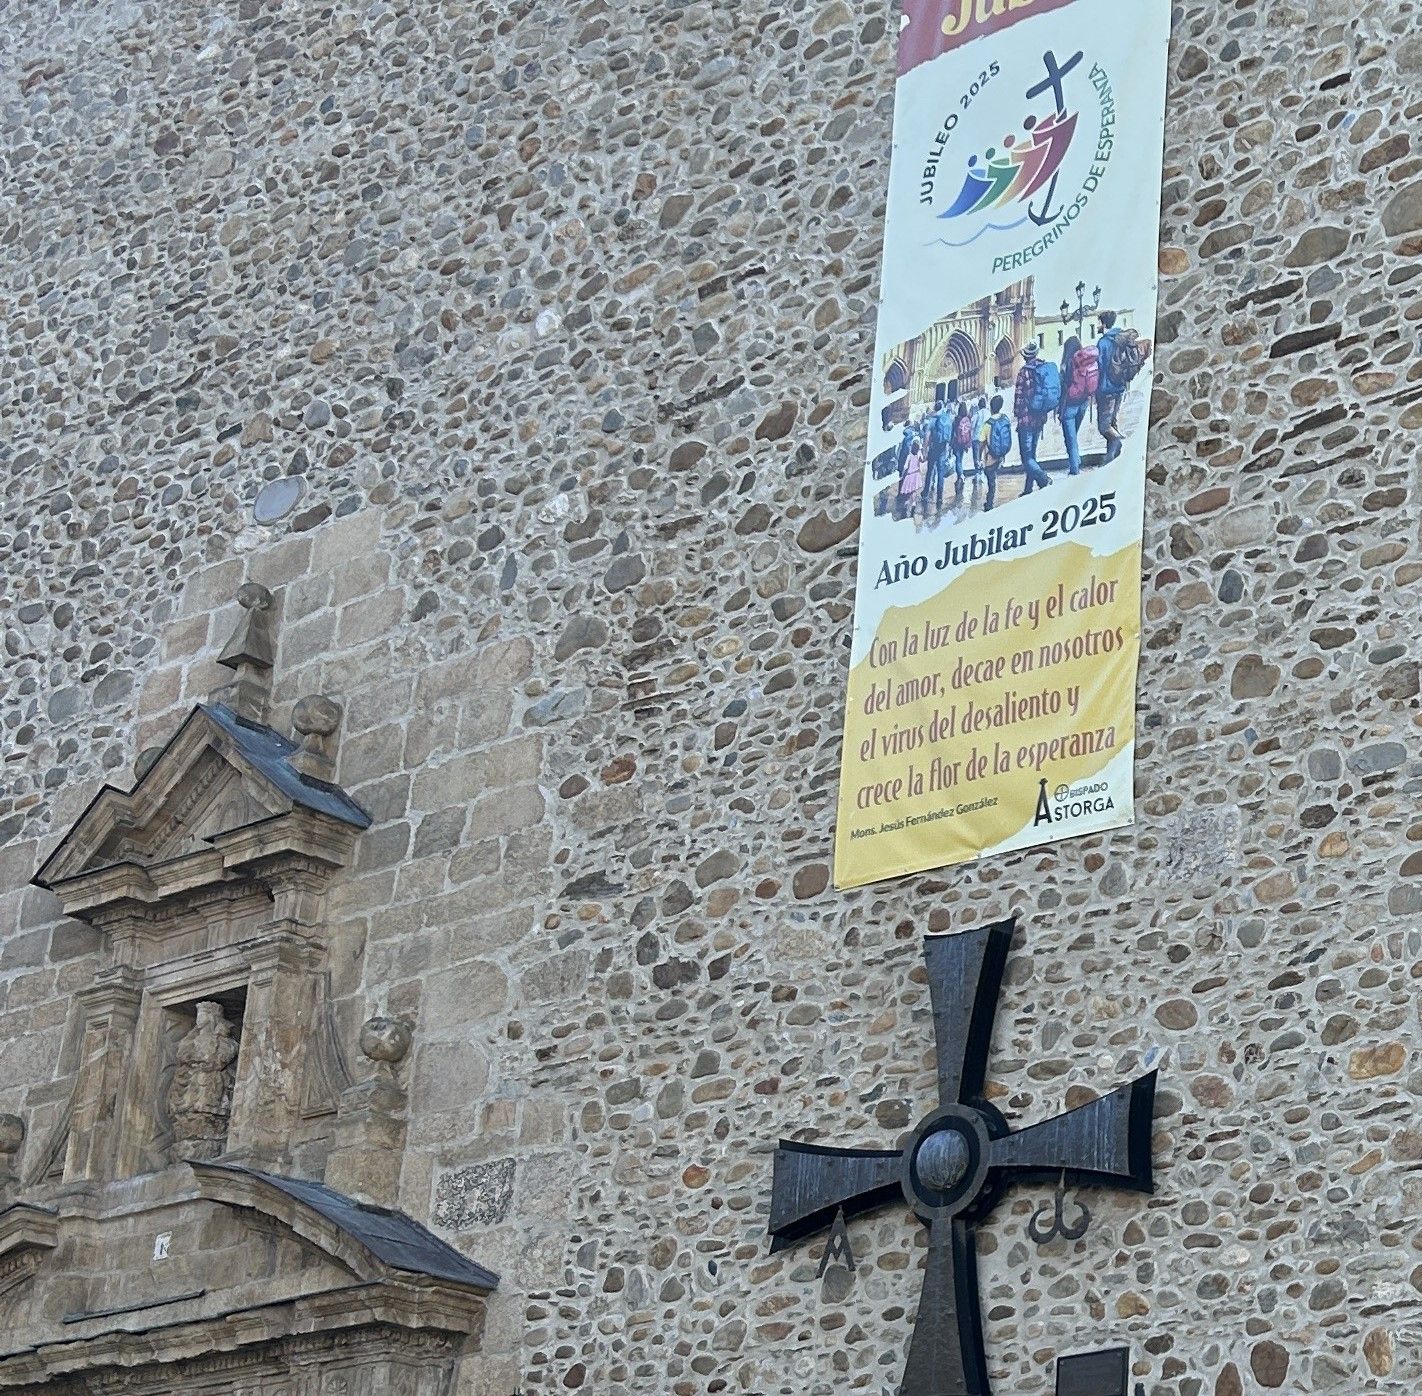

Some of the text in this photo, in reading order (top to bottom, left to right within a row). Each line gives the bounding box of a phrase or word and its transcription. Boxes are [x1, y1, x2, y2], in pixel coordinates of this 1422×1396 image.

[920, 60, 1001, 206] JUBILEO 2025
[992, 62, 1117, 274] PEREGRINOS DE ESPERANZA
[874, 491, 1117, 590] Año Jubilar 2025
[869, 575, 1120, 669] Con la luz de la fe y el calor
[864, 626, 1125, 715] del amor, decae en nosotros
[857, 724, 1116, 810] crece la flor de la esperanza
[860, 683, 1081, 762] el virus del desaliento y
[1034, 778, 1115, 827] ASTORGA
